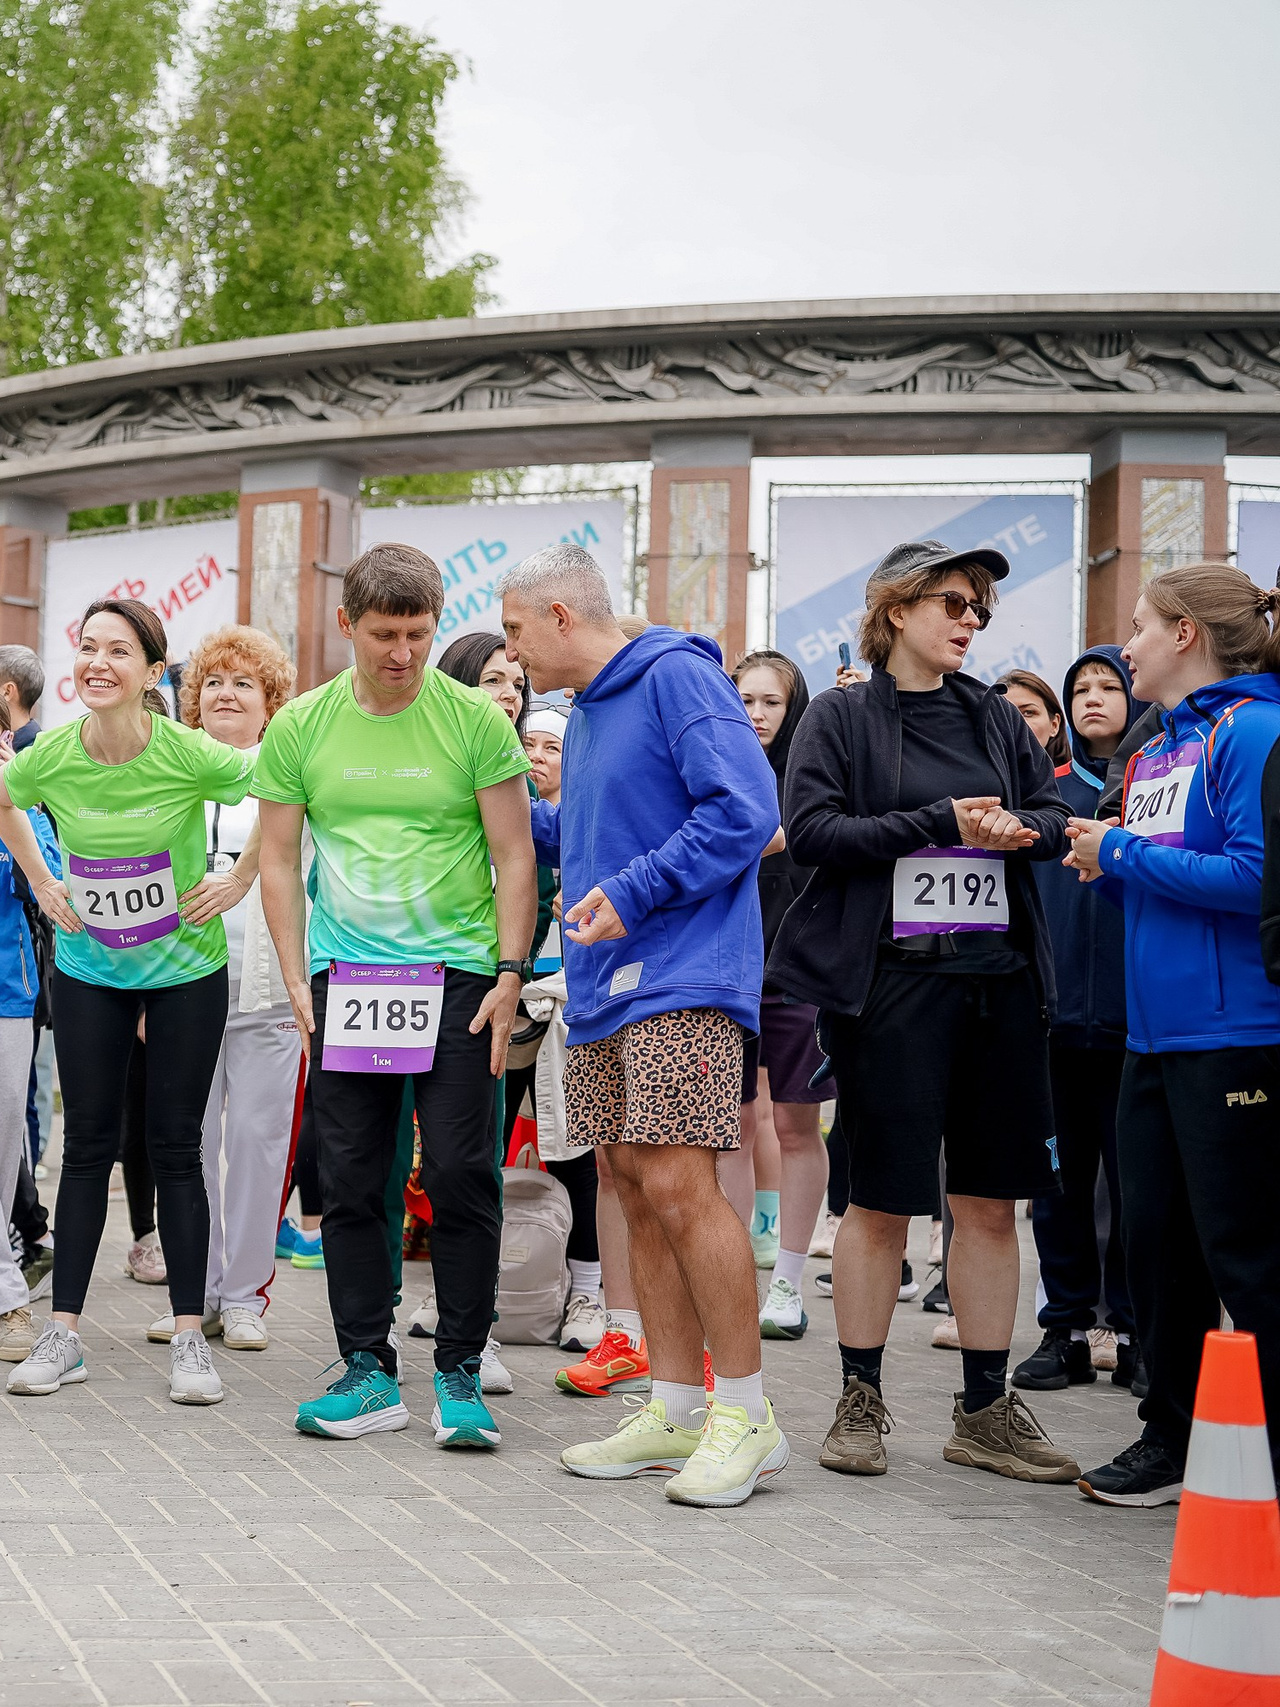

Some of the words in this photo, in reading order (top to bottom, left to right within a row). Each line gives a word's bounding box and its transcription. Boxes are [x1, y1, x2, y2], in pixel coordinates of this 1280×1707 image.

[443, 537, 508, 592] ЫТЬ
[85, 882, 165, 917] 2100
[914, 873, 998, 906] 2192
[344, 999, 429, 1031] 2185
[1226, 1089, 1268, 1107] FILA
